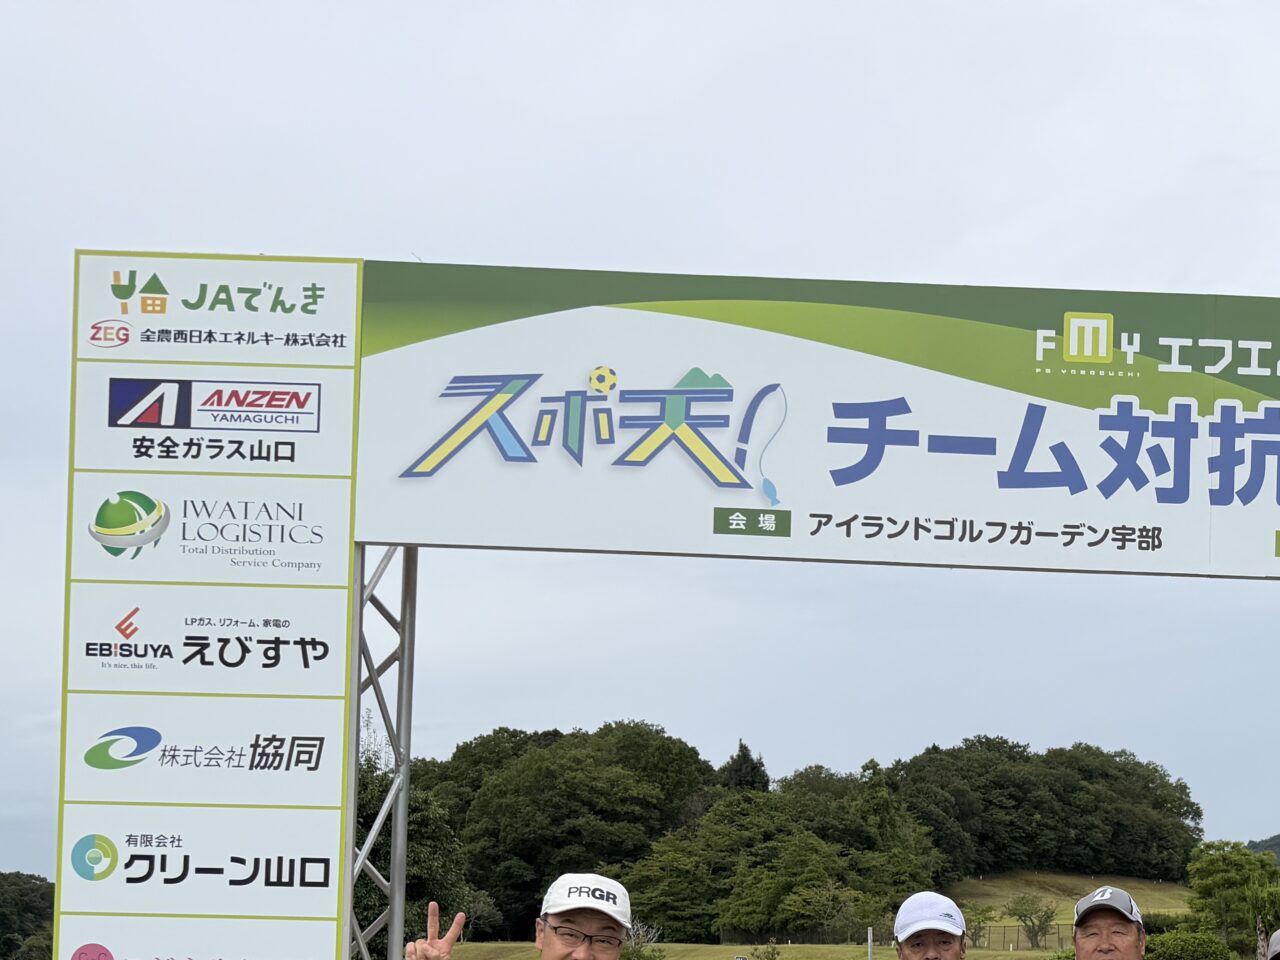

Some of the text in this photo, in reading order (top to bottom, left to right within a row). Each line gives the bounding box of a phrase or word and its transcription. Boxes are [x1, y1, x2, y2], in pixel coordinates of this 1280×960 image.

[181, 282, 325, 315] JAでんき
[90, 325, 130, 345] ZEG
[200, 389, 312, 410] ANZEN
[211, 412, 300, 425] YAMAGUCHI
[132, 436, 296, 462] 安全ガラス山口
[182, 500, 304, 521] IWATANI
[728, 511, 776, 532] 会場
[808, 512, 1163, 552] アイランドゴルフガーデン宇部
[181, 522, 324, 545] LOGISTICS
[180, 544, 276, 557] Total Distribution
[230, 557, 322, 571] Service Company
[182, 635, 330, 669] えびすや
[158, 734, 325, 772] 株式会社協同
[125, 834, 183, 848] 有限会社
[124, 854, 330, 888] クリーン山口
[568, 886, 617, 905] PRGR
